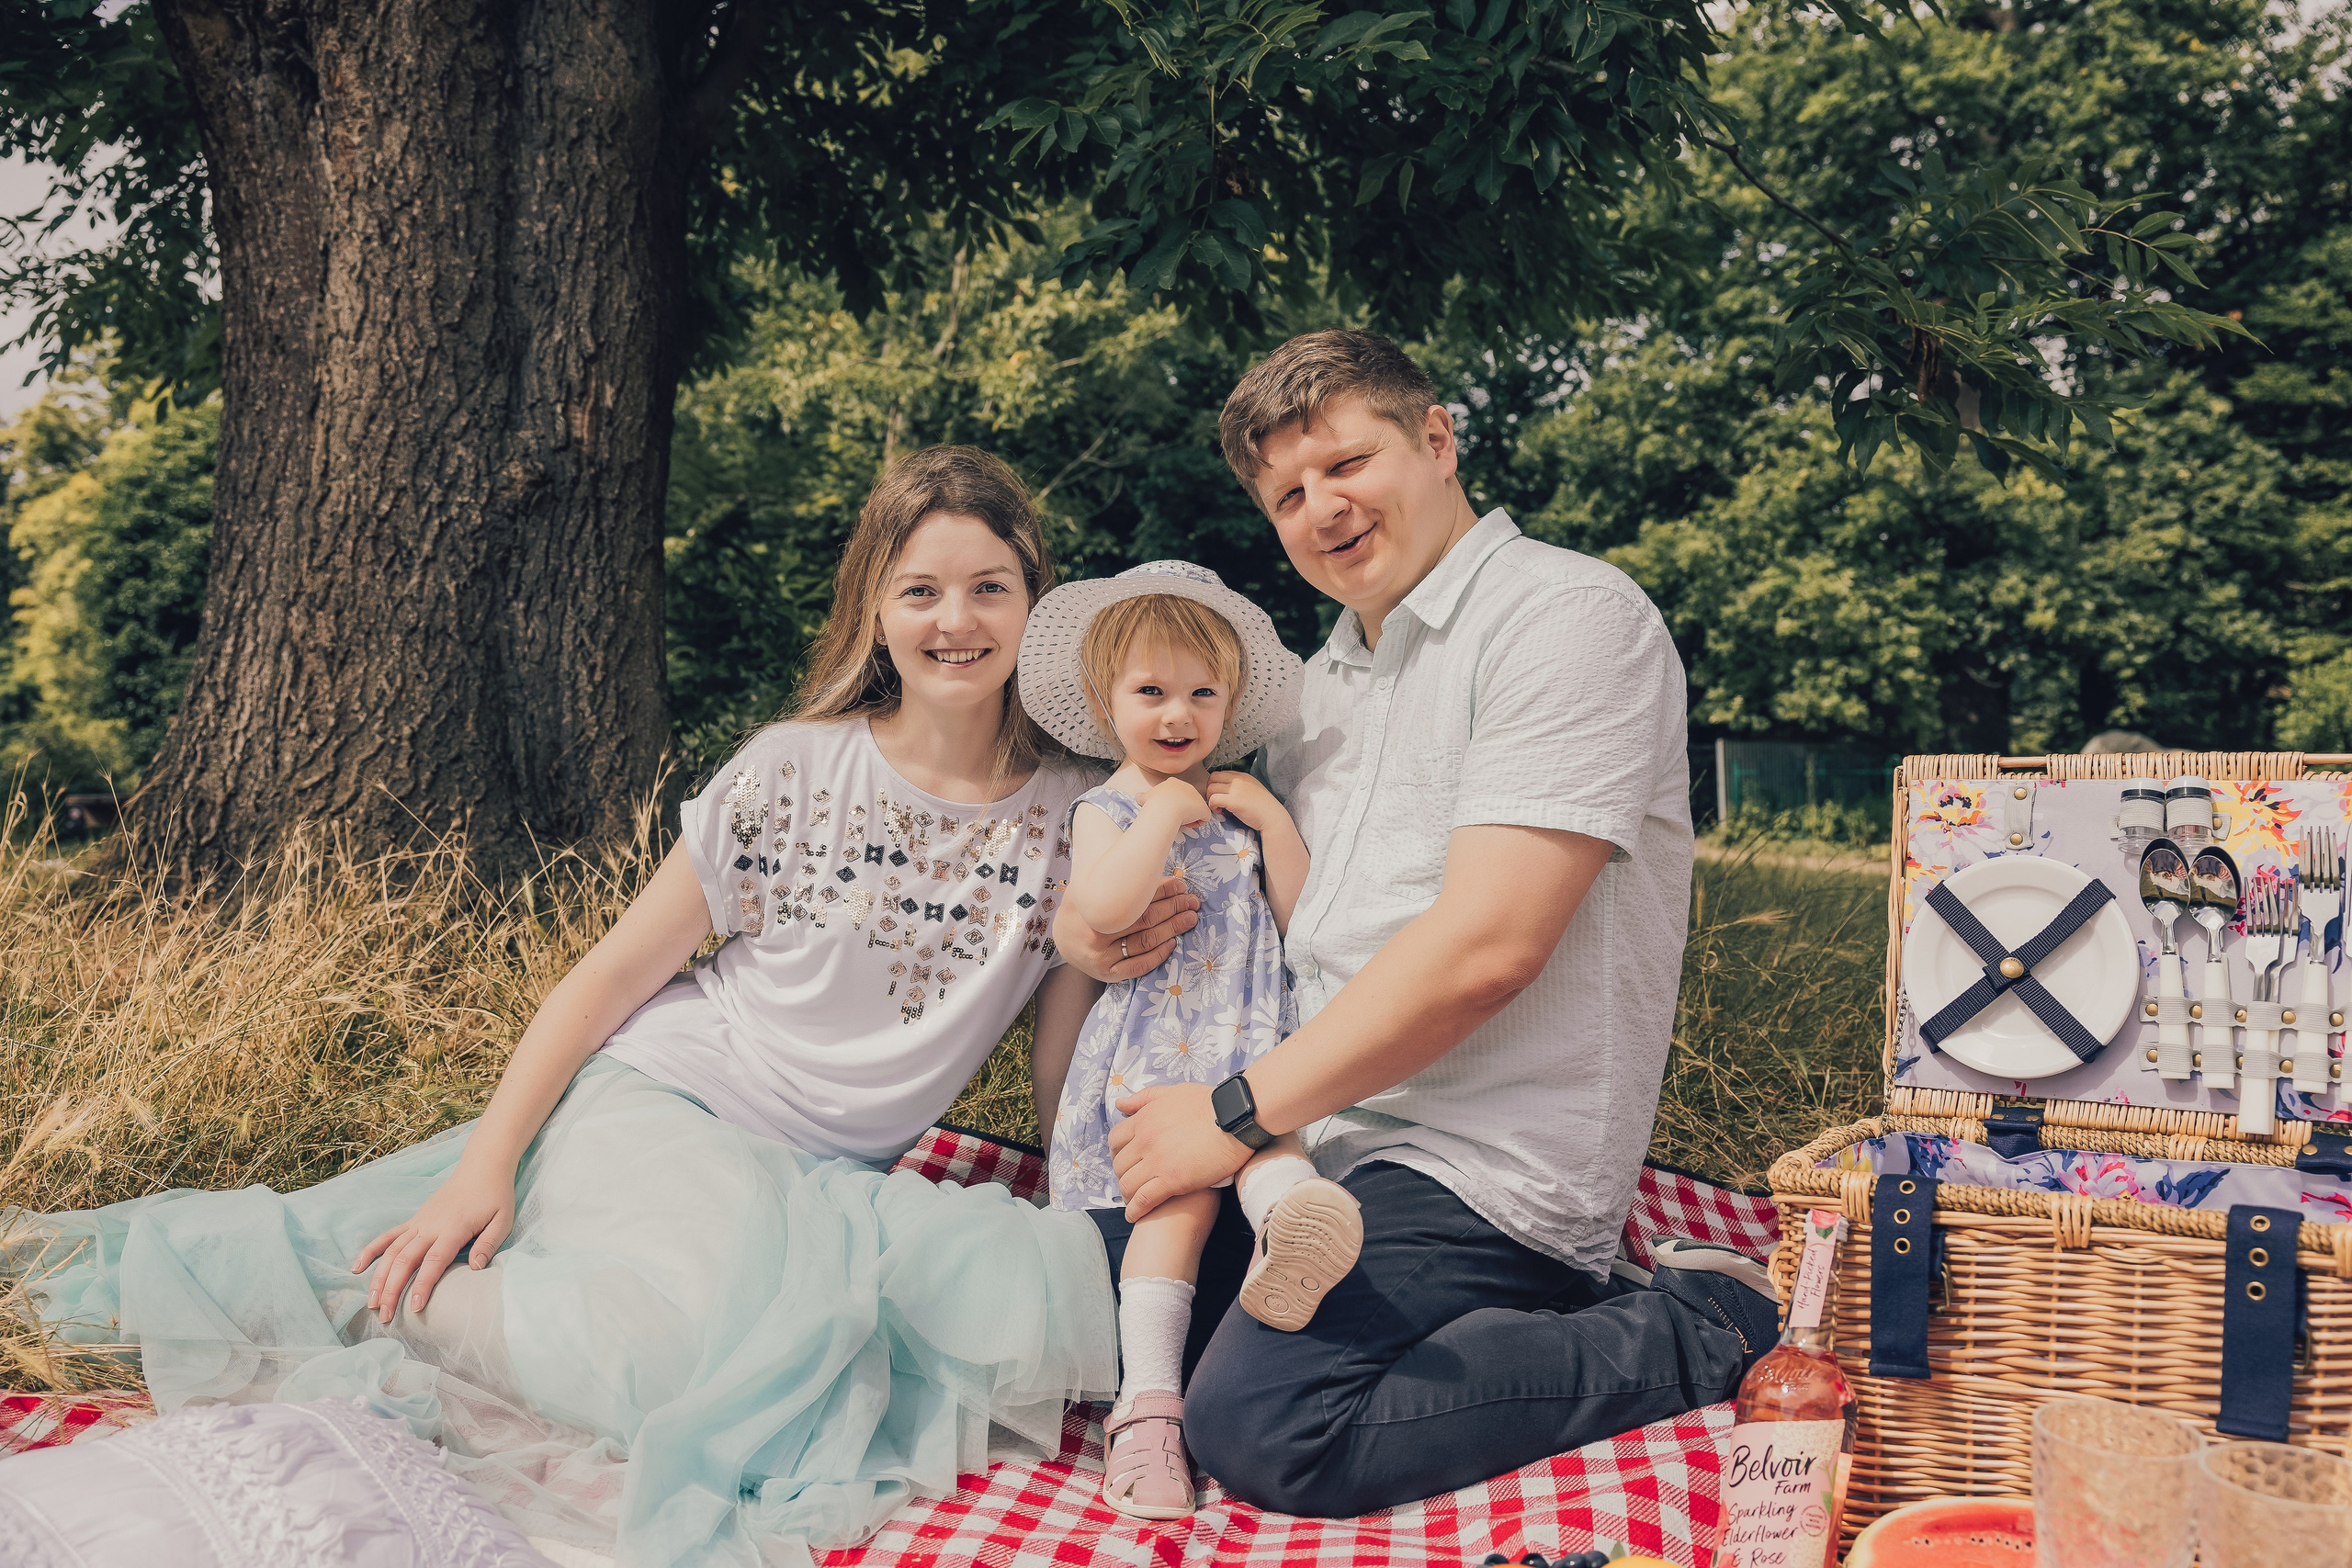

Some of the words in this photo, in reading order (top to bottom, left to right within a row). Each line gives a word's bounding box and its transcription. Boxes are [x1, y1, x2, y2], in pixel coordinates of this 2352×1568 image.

[1797, 1247, 1817, 1309] Hand-Picked
[1810, 1265, 1825, 1297] Flowers
[1728, 1444, 1817, 1487] Belvoir
[1774, 1480, 1811, 1495] Farm
[1728, 1501, 1798, 1525] Sparkling
[1722, 1525, 1798, 1547] Elderflower
[1749, 1548, 1786, 1568] Rose
